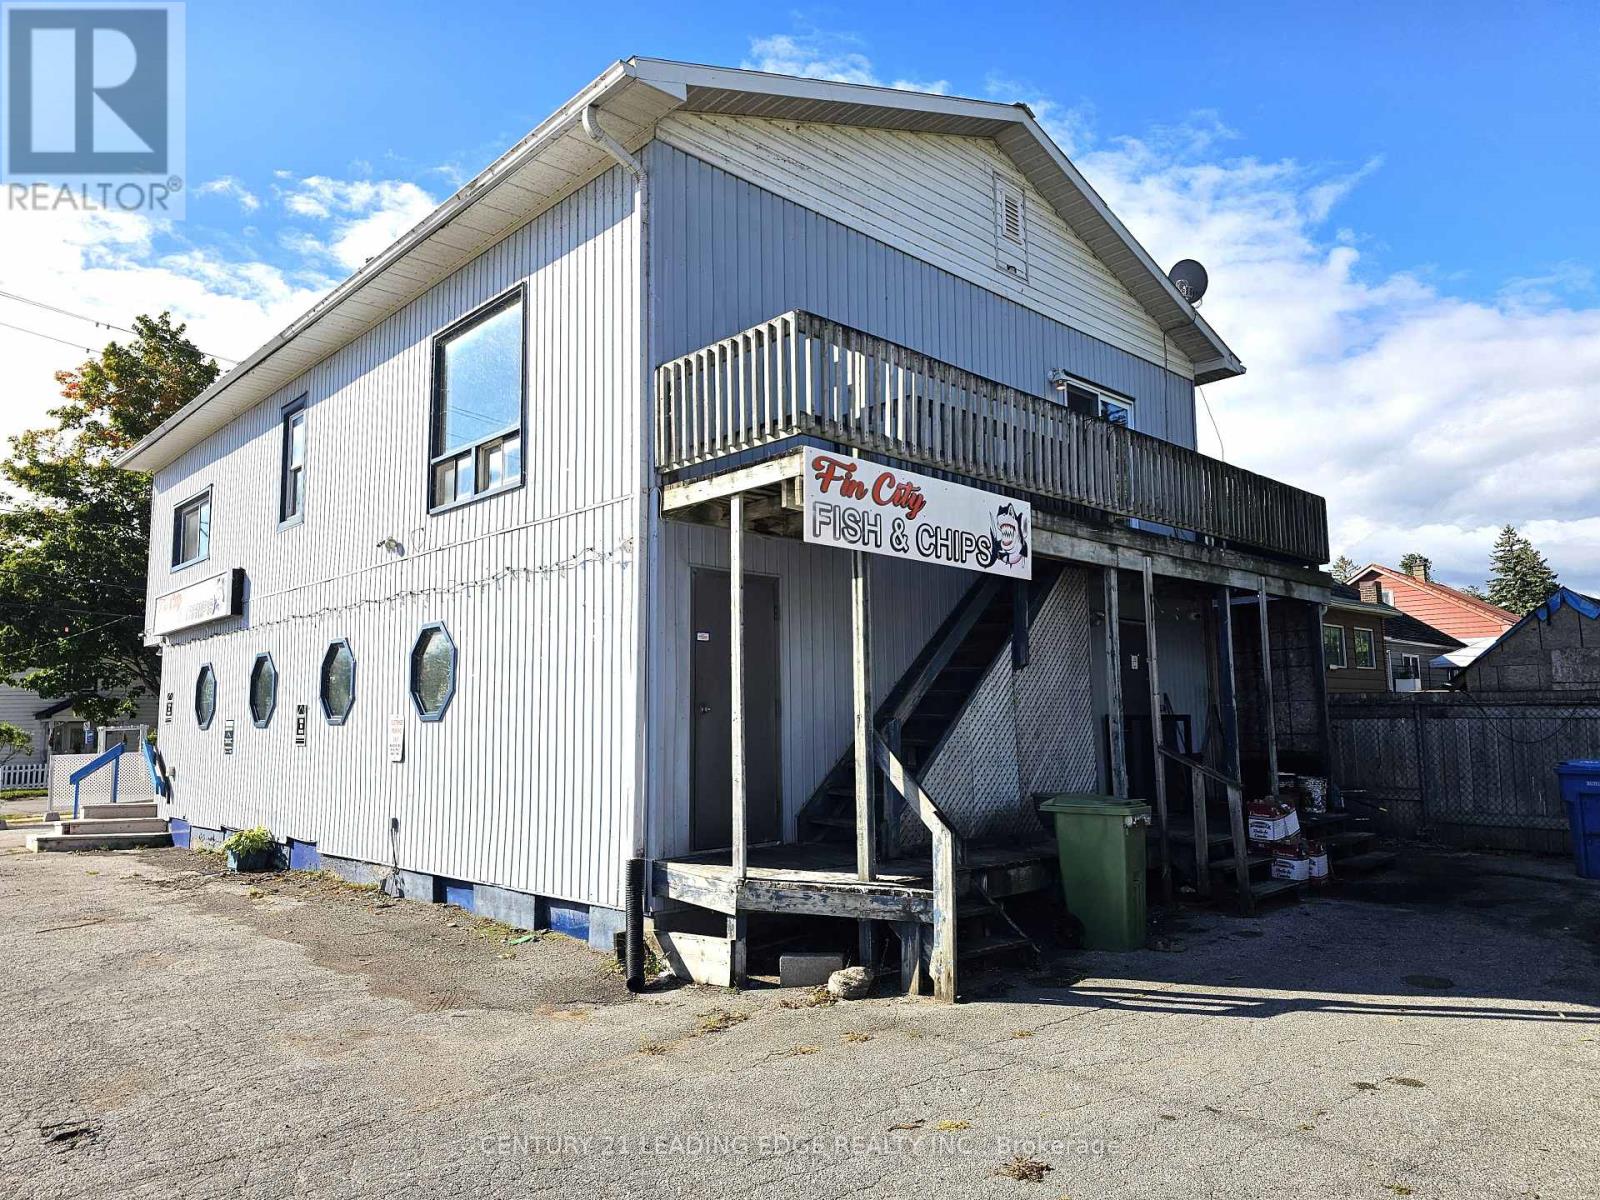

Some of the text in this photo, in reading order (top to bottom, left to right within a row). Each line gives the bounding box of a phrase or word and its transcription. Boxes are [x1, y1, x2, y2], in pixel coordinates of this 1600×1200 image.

[812, 455, 927, 520] Fin City
[812, 501, 993, 568] FISH & CHIPS
